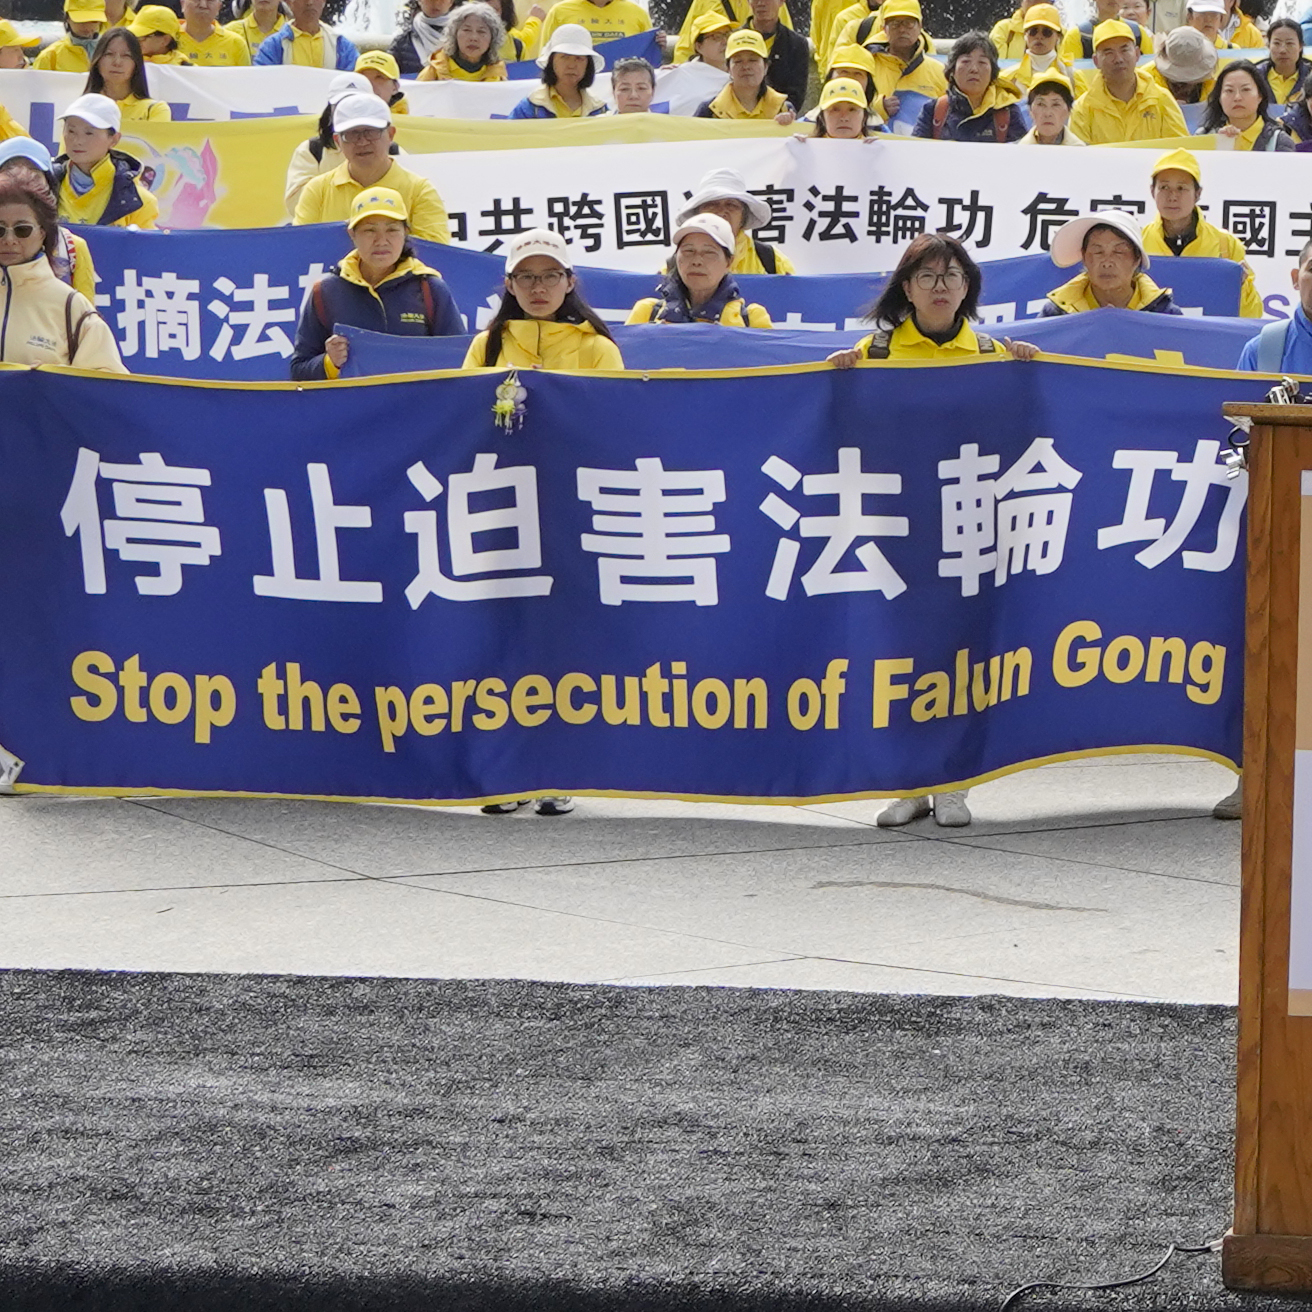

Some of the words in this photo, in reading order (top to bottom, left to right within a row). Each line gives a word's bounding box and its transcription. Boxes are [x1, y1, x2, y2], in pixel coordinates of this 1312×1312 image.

[60, 437, 1248, 610] 停止迫害法輪功
[69, 650, 237, 745] Stop
[256, 662, 362, 735] the
[373, 662, 768, 753] persecution
[786, 657, 850, 732] of
[871, 645, 1033, 730] Falun
[1051, 619, 1227, 706] Gong
